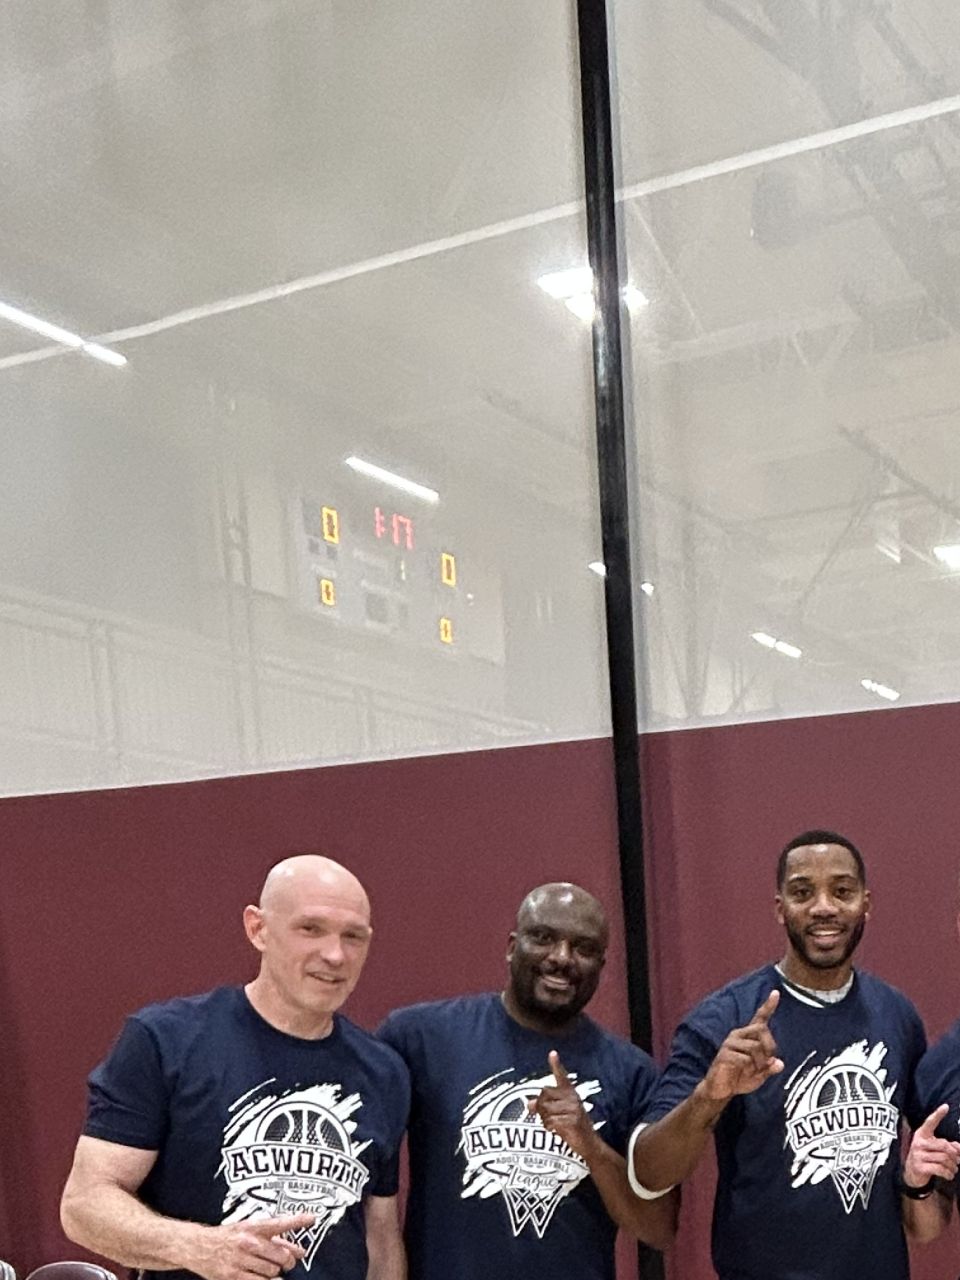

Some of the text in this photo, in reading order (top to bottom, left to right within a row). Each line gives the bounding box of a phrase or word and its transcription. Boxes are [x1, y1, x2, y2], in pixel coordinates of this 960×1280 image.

[321, 506, 339, 543] 0
[441, 552, 457, 587] 0
[794, 1106, 897, 1144] ACWORTH
[231, 1148, 362, 1193] ACWORTH
[836, 1149, 873, 1167] League
[510, 1167, 555, 1191] League
